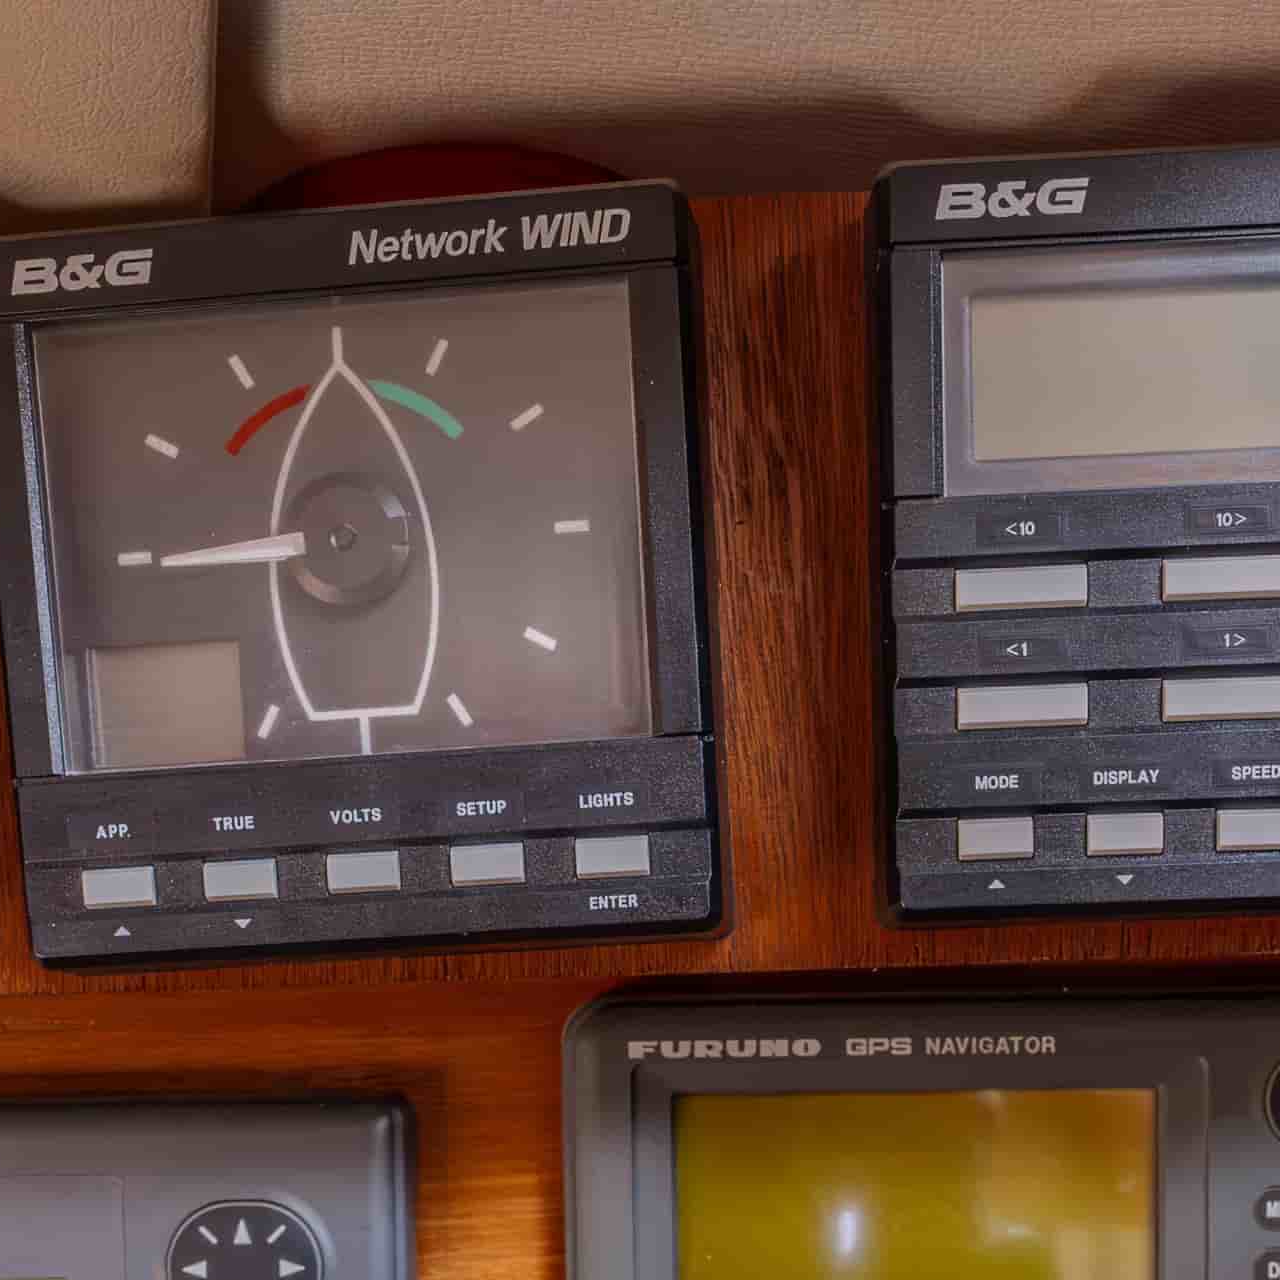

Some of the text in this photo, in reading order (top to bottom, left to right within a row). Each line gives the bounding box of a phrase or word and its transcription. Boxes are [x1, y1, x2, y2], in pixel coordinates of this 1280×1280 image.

[935, 176, 1090, 222] B&G
[10, 206, 631, 297] B&G Network WIND
[974, 773, 1019, 792] MODE
[1092, 767, 1161, 788] DISPLAY
[455, 799, 507, 819] SETUP
[578, 791, 635, 811] LIGHTS
[212, 815, 256, 833] TRUE
[329, 807, 383, 826] VOLTS
[95, 822, 132, 841] APP.
[588, 892, 639, 911] ENTER
[627, 1034, 1057, 1060] FURUNO GPS NAVIGATOR
